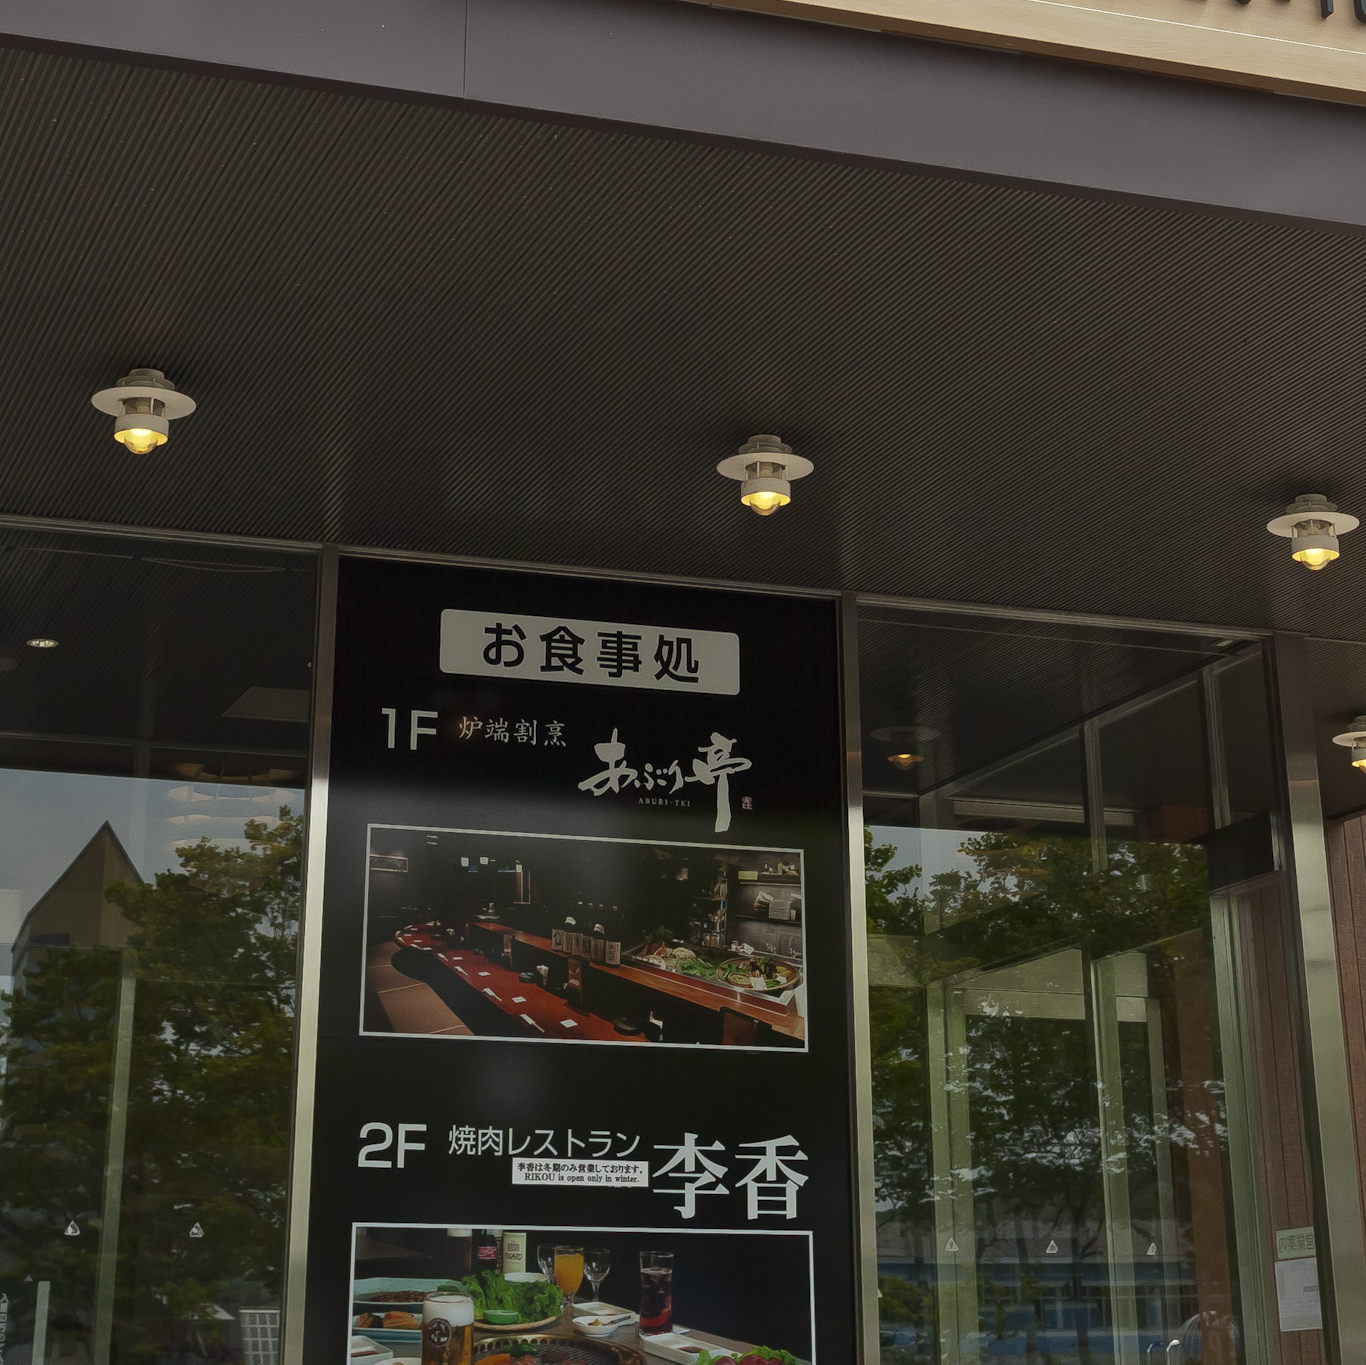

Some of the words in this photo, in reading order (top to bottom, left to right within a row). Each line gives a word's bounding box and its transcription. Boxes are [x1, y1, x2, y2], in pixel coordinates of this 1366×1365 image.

[482, 622, 700, 684] お食事処
[381, 707, 439, 751] 1F
[458, 715, 568, 748] 炉端割烹
[357, 1121, 428, 1169] 2F
[448, 1124, 641, 1158] 焼肉レストラン
[524, 1172, 556, 1182] RIKOU
[558, 1173, 565, 1182] is
[567, 1175, 585, 1183] open
[587, 1174, 603, 1184] only
[605, 1174, 613, 1183] in
[652, 1132, 810, 1220] 李香
